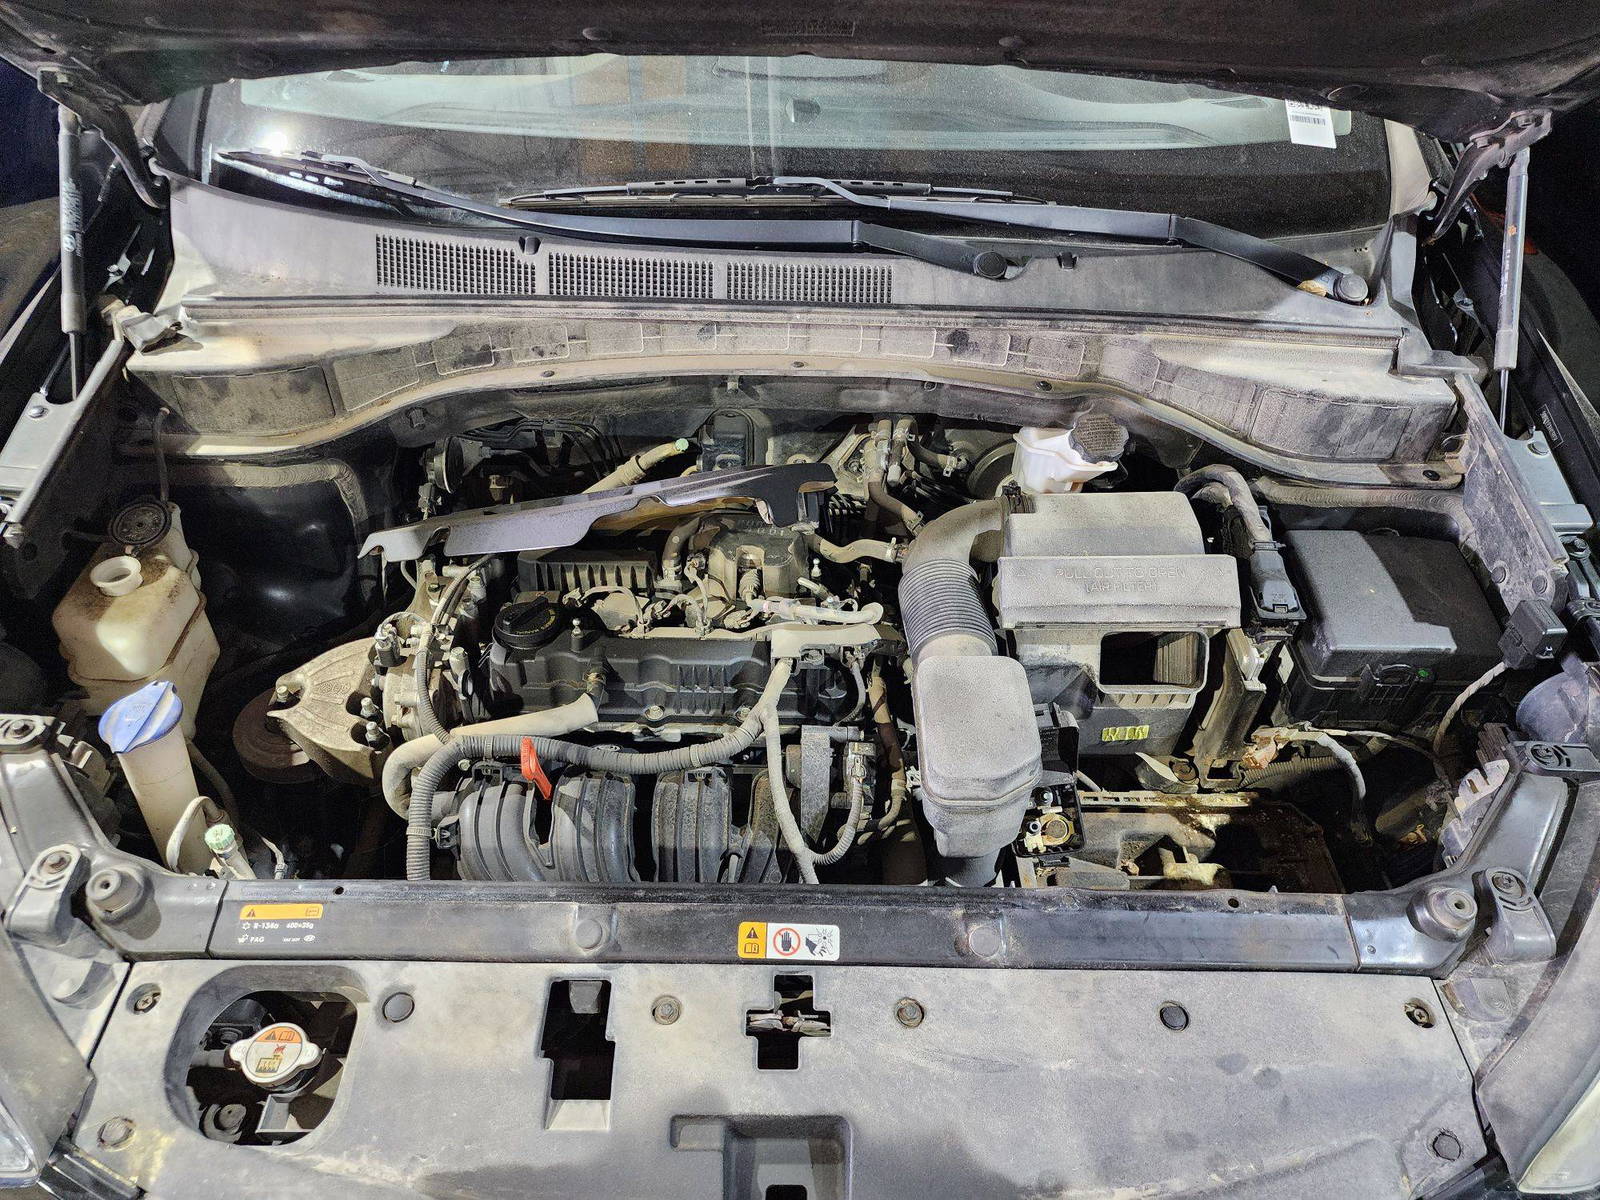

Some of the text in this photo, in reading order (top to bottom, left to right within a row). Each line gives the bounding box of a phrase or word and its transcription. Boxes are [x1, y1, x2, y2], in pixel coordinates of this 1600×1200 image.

[1055, 567, 1186, 579] PULL OUT TO OPEN
